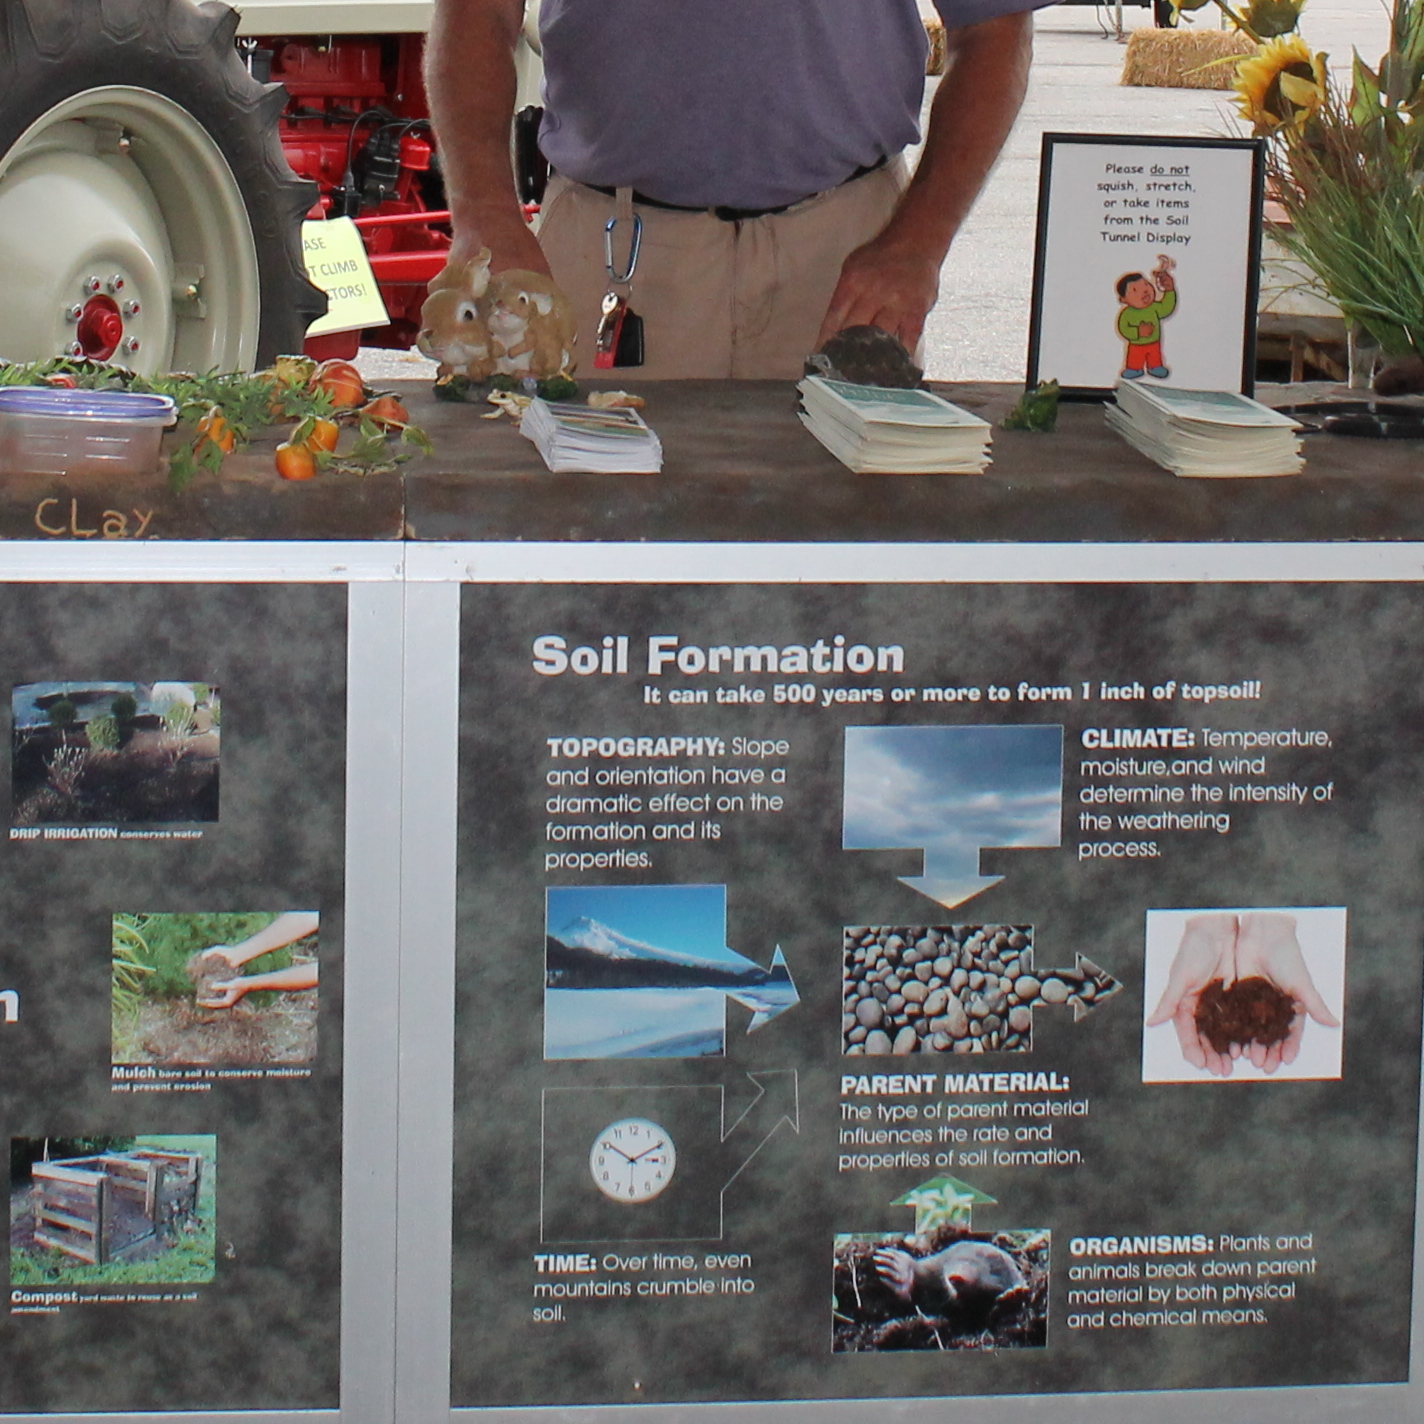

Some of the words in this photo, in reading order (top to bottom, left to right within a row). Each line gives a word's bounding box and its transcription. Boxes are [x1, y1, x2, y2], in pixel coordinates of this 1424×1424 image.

[1105, 163, 1144, 174] Please
[1150, 164, 1164, 175] do
[1170, 165, 1190, 175] not
[1096, 181, 1139, 193] squish,
[1146, 180, 1196, 193] stretch,
[1103, 199, 1118, 209] or
[1122, 197, 1150, 208] take
[1156, 198, 1190, 209] items
[1103, 213, 1134, 225] from
[1139, 214, 1160, 226] the
[1165, 214, 1189, 226] Soil
[1100, 231, 1141, 243] Tunnel
[1146, 231, 1192, 247] Display
[320, 260, 358, 275] CLIMB
[532, 635, 629, 676] Soil
[647, 634, 904, 675] Formation
[644, 685, 662, 704] It
[668, 689, 709, 704] can
[715, 684, 766, 704] take
[773, 683, 816, 703] 500
[821, 688, 884, 708] years
[890, 688, 916, 702] or
[922, 687, 981, 702] more
[987, 684, 1011, 702] to
[1017, 681, 1073, 701] form
[1082, 681, 1090, 700] 1
[1100, 681, 1145, 700] inch
[1152, 680, 1177, 700] of
[1181, 680, 1261, 704] topsoil!
[546, 736, 726, 758] TOPOGRAPHY:
[731, 736, 790, 760] Slope
[1081, 727, 1196, 749] CLIMATE:
[1201, 727, 1333, 751] Temperature,
[546, 766, 589, 786] and
[595, 765, 706, 786] orientation
[712, 765, 765, 785] have
[770, 768, 786, 784] a
[1218, 755, 1266, 775] wind
[545, 793, 642, 814] dramatic
[648, 792, 711, 813] effect
[716, 796, 744, 812] on
[749, 792, 784, 811] the
[1079, 784, 1185, 804] determine
[1190, 783, 1224, 802] the
[1229, 782, 1308, 805] intensity
[1312, 781, 1334, 802] of
[545, 821, 646, 841] formation
[652, 820, 695, 840] and
[701, 820, 721, 839] its
[1078, 811, 1112, 831] the
[1117, 810, 1230, 834] weathering
[9, 828, 41, 840] DRIP
[43, 827, 118, 839] IRRIGATION
[544, 848, 653, 873] properties.
[1078, 841, 1161, 862] process.
[111, 1065, 156, 1079] Mulch
[841, 1074, 938, 1095] PARENT
[944, 1071, 1070, 1094] MATERIAL:
[839, 1103, 873, 1121] The
[877, 1102, 919, 1123] type
[923, 1101, 943, 1120] of
[947, 1100, 1009, 1122] parent
[1013, 1098, 1089, 1117] material
[839, 1127, 933, 1145] influences
[937, 1125, 968, 1143] the
[973, 1124, 1010, 1143] rate
[1014, 1123, 1053, 1142] and
[838, 1150, 930, 1173] properties
[935, 1149, 955, 1168] of
[958, 1149, 988, 1167] soil
[992, 1147, 1085, 1167] formation.
[1069, 1234, 1214, 1257] ORGANISMS:
[1219, 1233, 1271, 1252] Plants
[1275, 1232, 1313, 1251] and
[533, 1253, 597, 1273] TIME:
[602, 1253, 648, 1271] Over
[652, 1252, 698, 1271] time,
[704, 1254, 752, 1270] even
[1068, 1261, 1140, 1281] animals
[1145, 1260, 1197, 1279] break
[1201, 1259, 1252, 1277] down
[1256, 1257, 1317, 1279] parent
[11, 1290, 78, 1306] Compost
[533, 1279, 632, 1298] mountains
[636, 1277, 716, 1296] crumble
[720, 1276, 755, 1294] into
[1068, 1285, 1143, 1305] material
[1148, 1285, 1171, 1305] by
[1175, 1283, 1218, 1302] both
[1222, 1280, 1296, 1304] physical
[532, 1304, 566, 1323] soil.
[1067, 1310, 1105, 1329] and
[1109, 1307, 1197, 1327] chemical
[1201, 1309, 1268, 1325] means.
